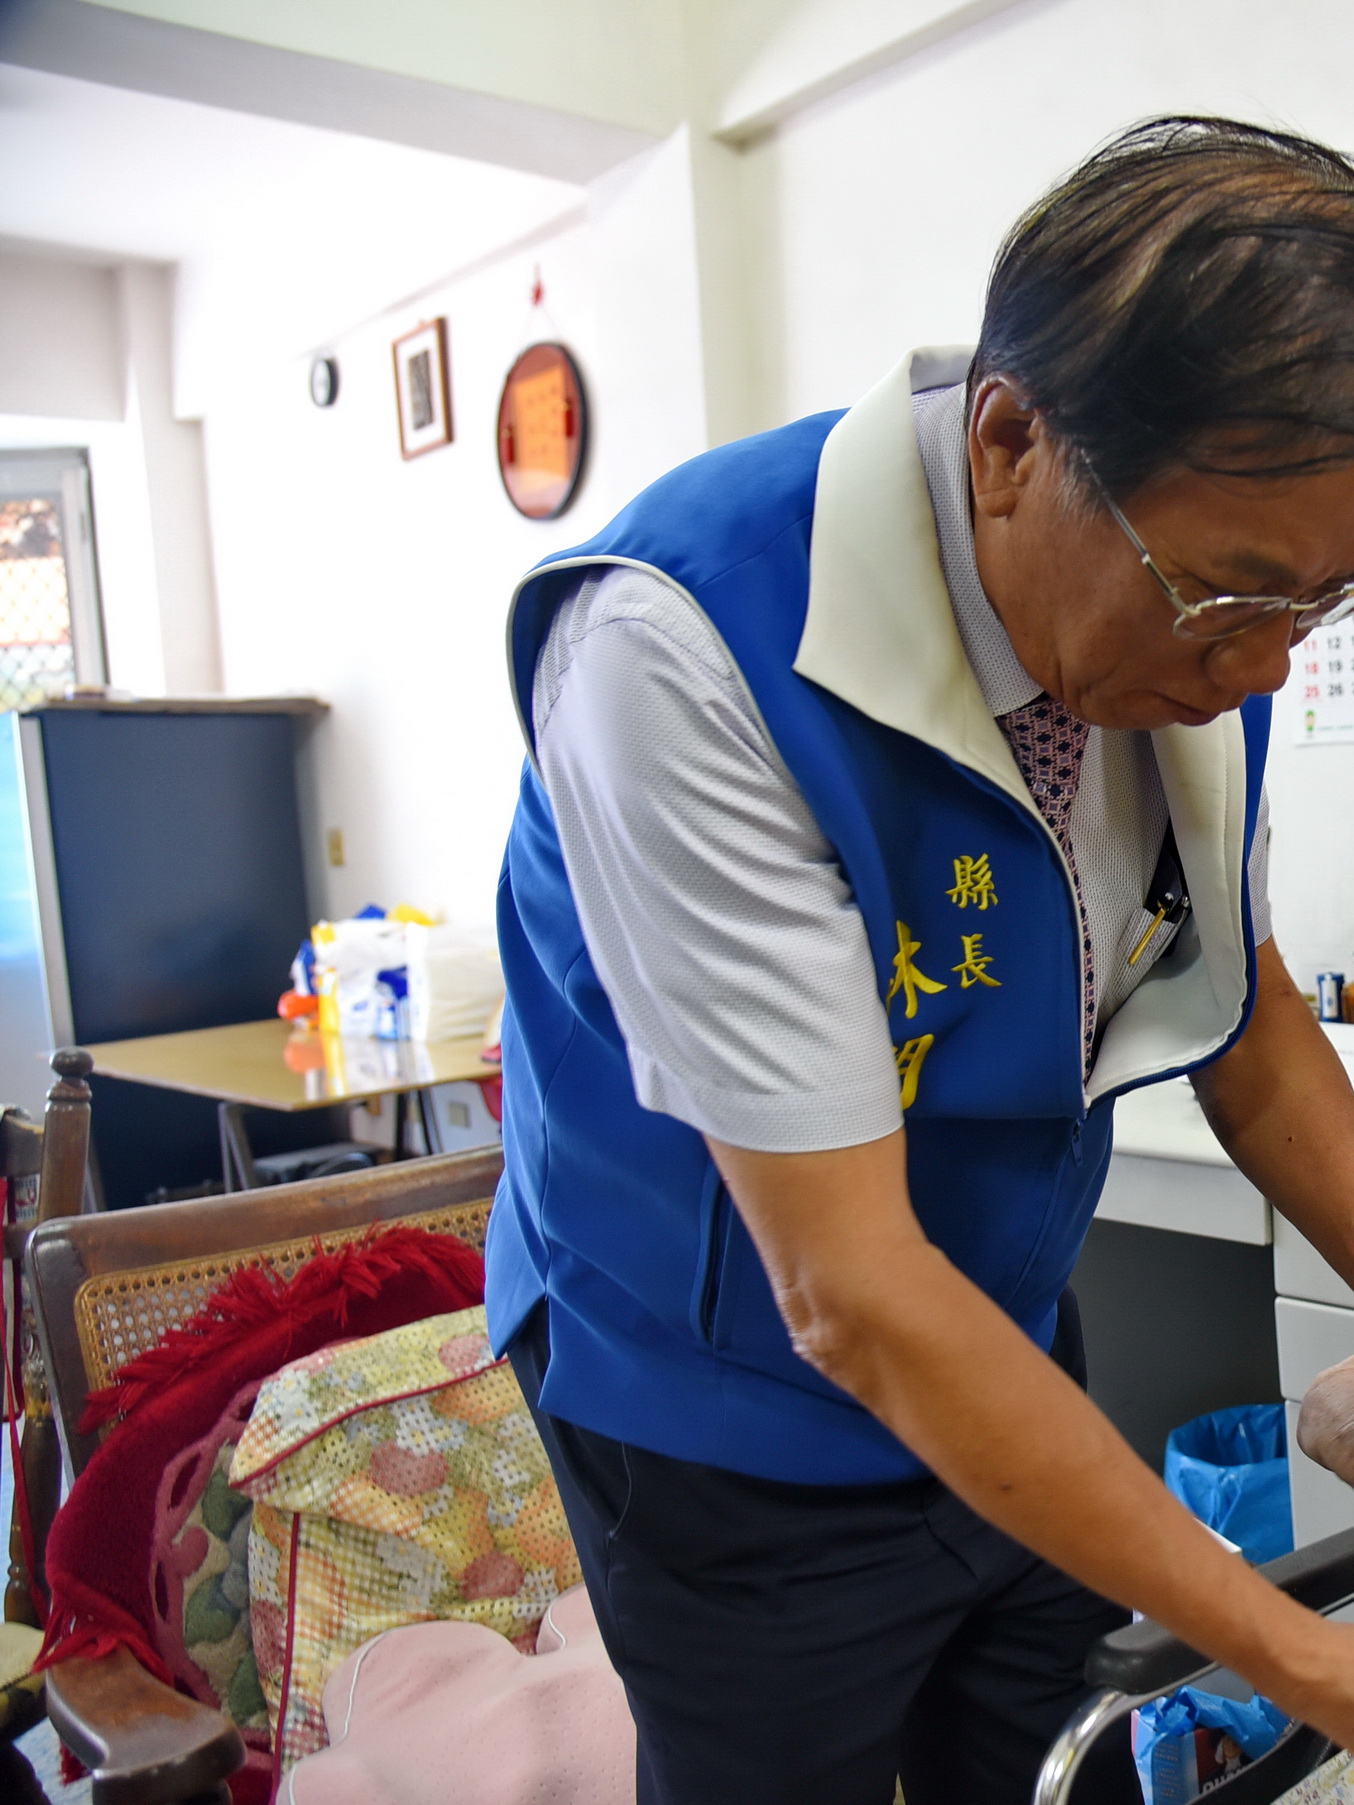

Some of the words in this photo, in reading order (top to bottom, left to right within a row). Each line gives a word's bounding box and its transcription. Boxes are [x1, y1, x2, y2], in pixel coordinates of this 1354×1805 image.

[1304, 641, 1317, 651] 11
[1327, 637, 1341, 649] 12
[1328, 660, 1342, 672] 19
[1328, 684, 1343, 696] 26
[945, 853, 1003, 990] 縣長
